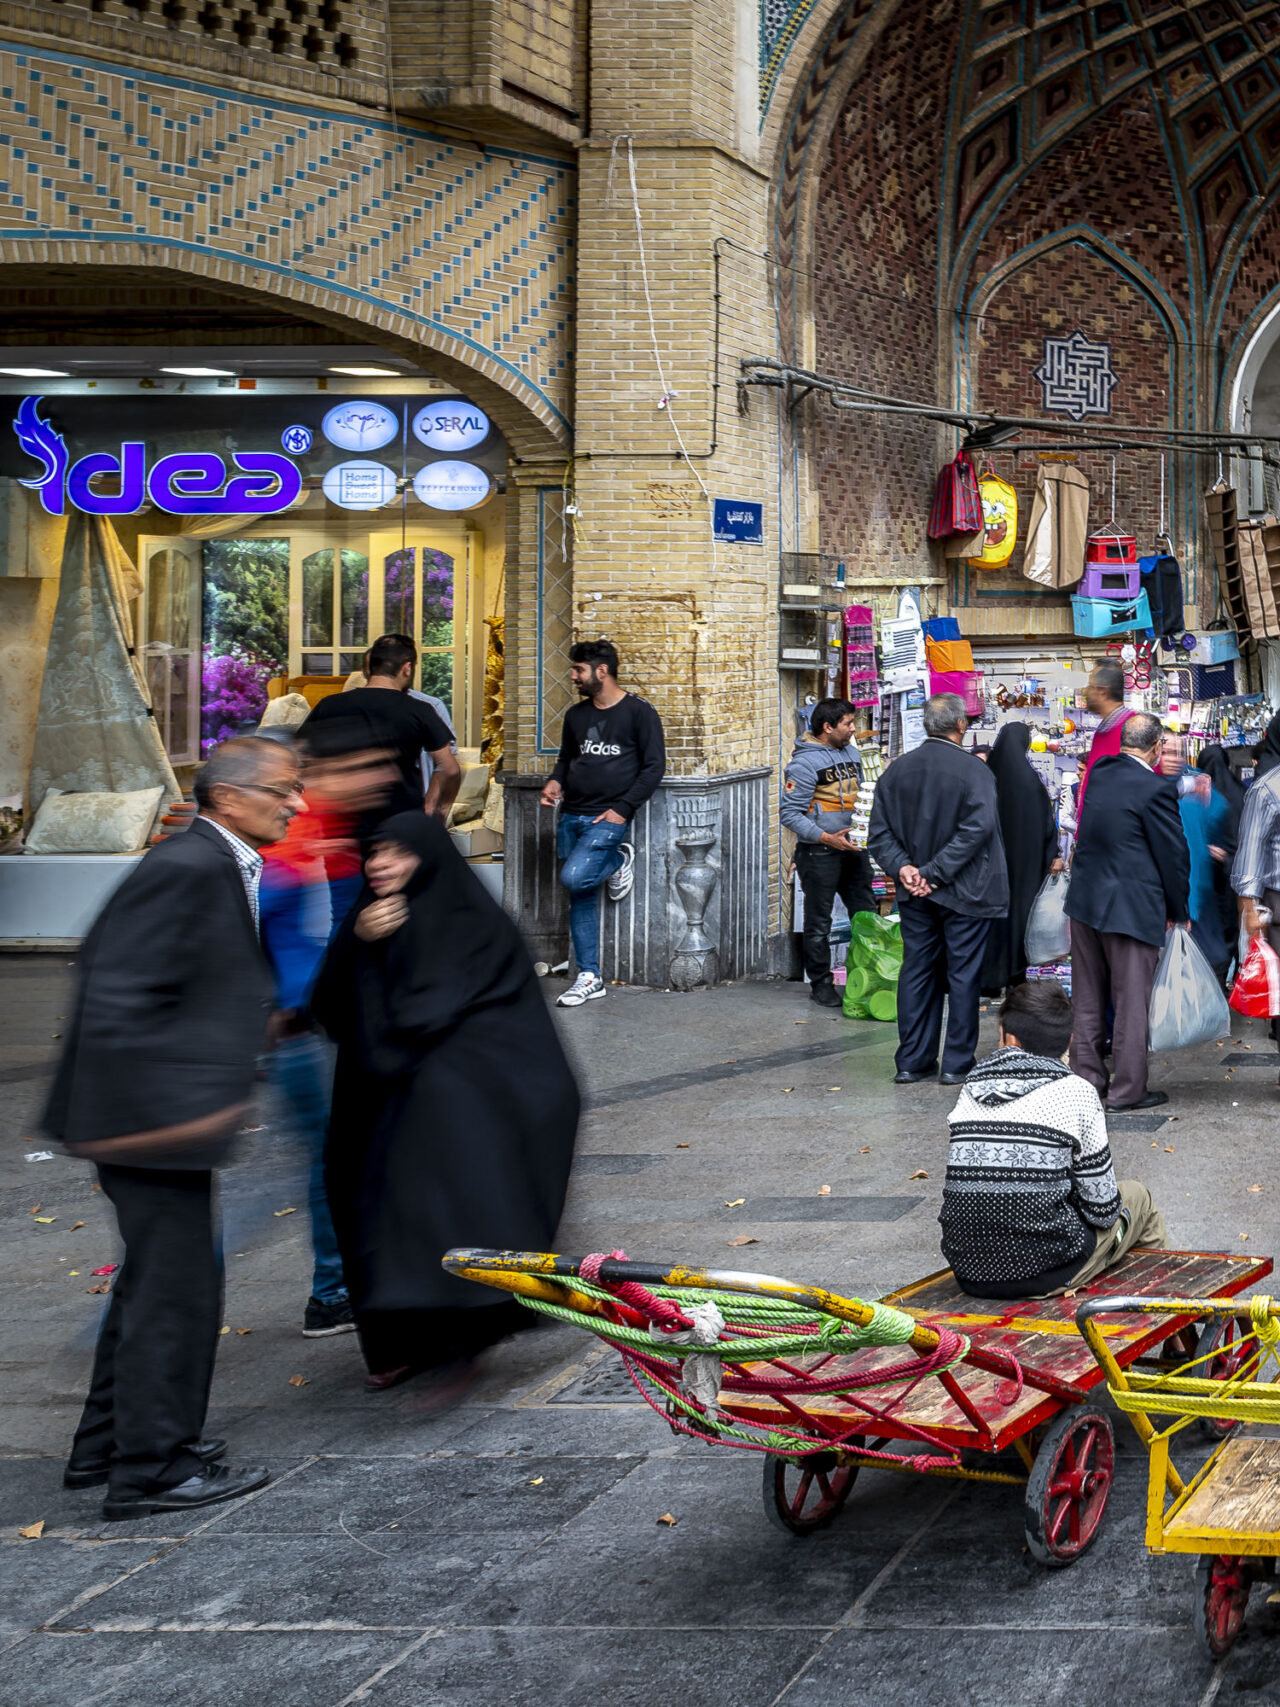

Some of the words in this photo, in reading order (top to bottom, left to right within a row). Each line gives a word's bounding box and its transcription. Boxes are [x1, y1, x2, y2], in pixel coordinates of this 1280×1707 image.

[435, 416, 484, 436] SERAL
[345, 472, 378, 482] Home
[345, 490, 378, 499] Home
